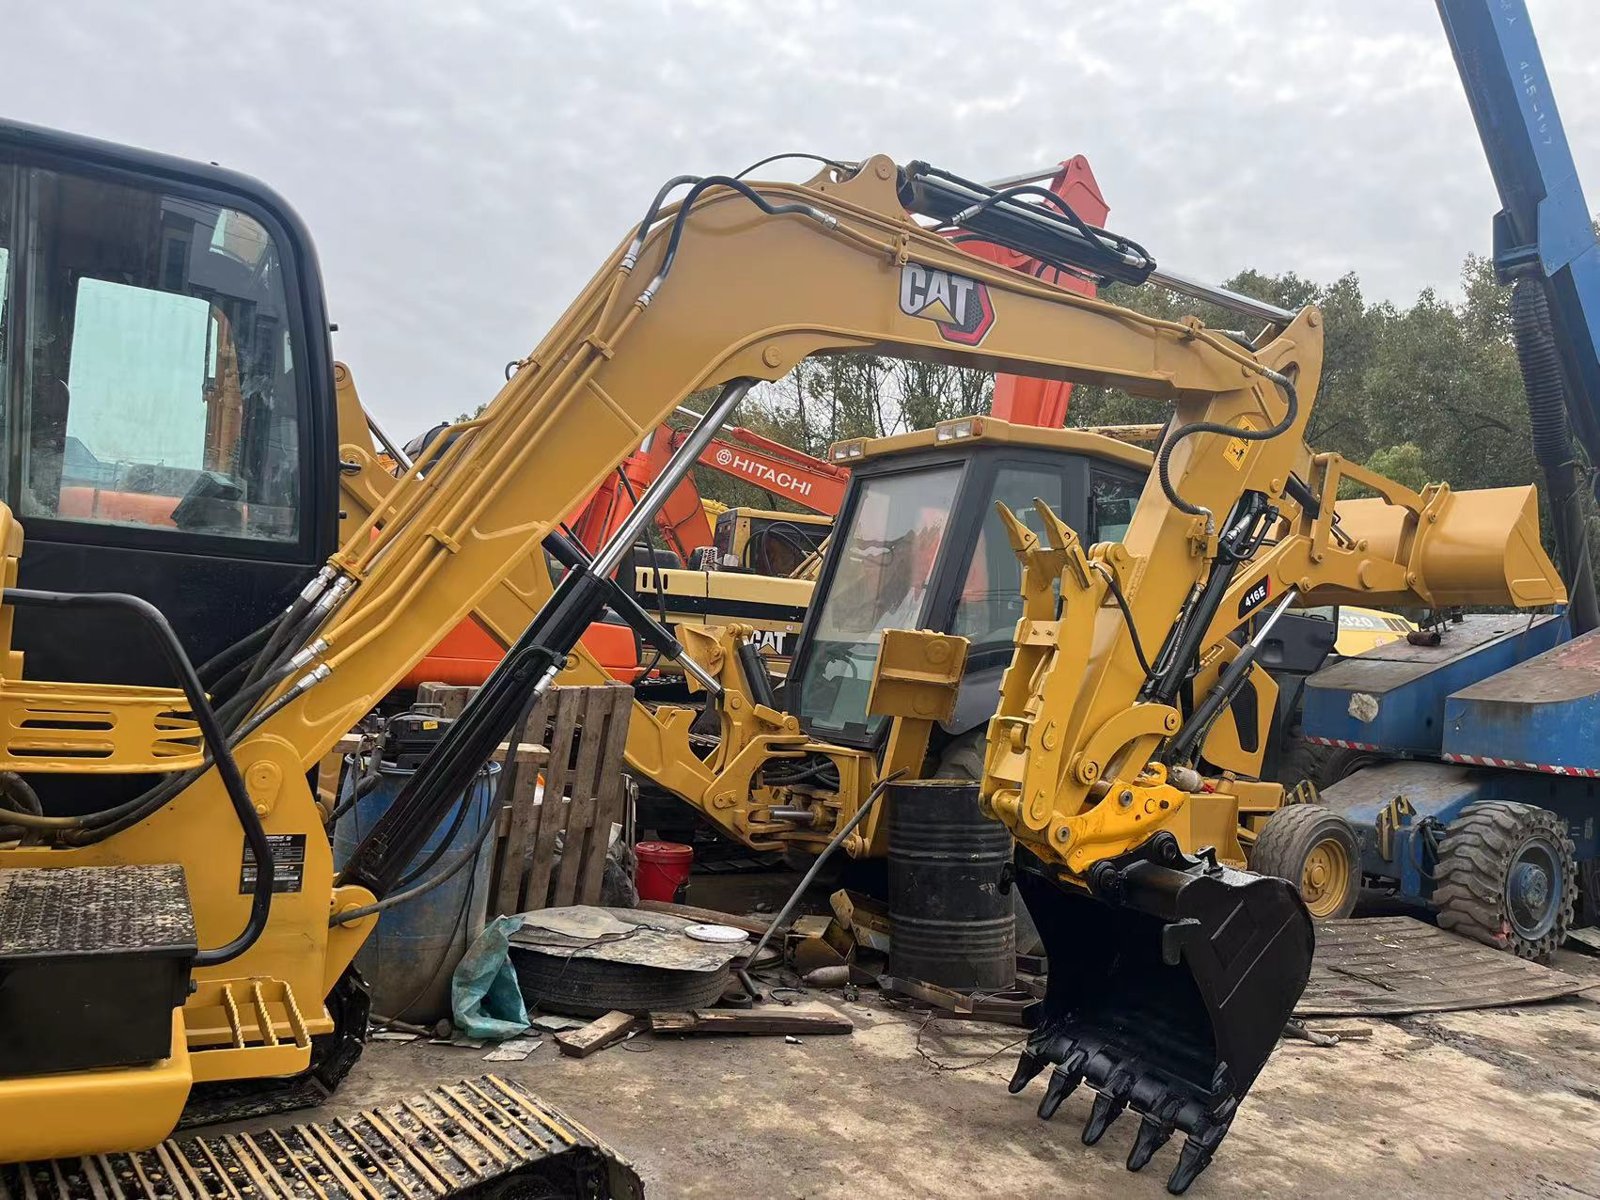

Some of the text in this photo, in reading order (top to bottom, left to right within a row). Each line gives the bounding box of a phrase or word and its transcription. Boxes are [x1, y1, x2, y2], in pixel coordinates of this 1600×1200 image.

[901, 263, 974, 326] CAT
[732, 455, 812, 496] HITACHI
[1245, 585, 1266, 607] 416E
[750, 629, 787, 655] CAT
